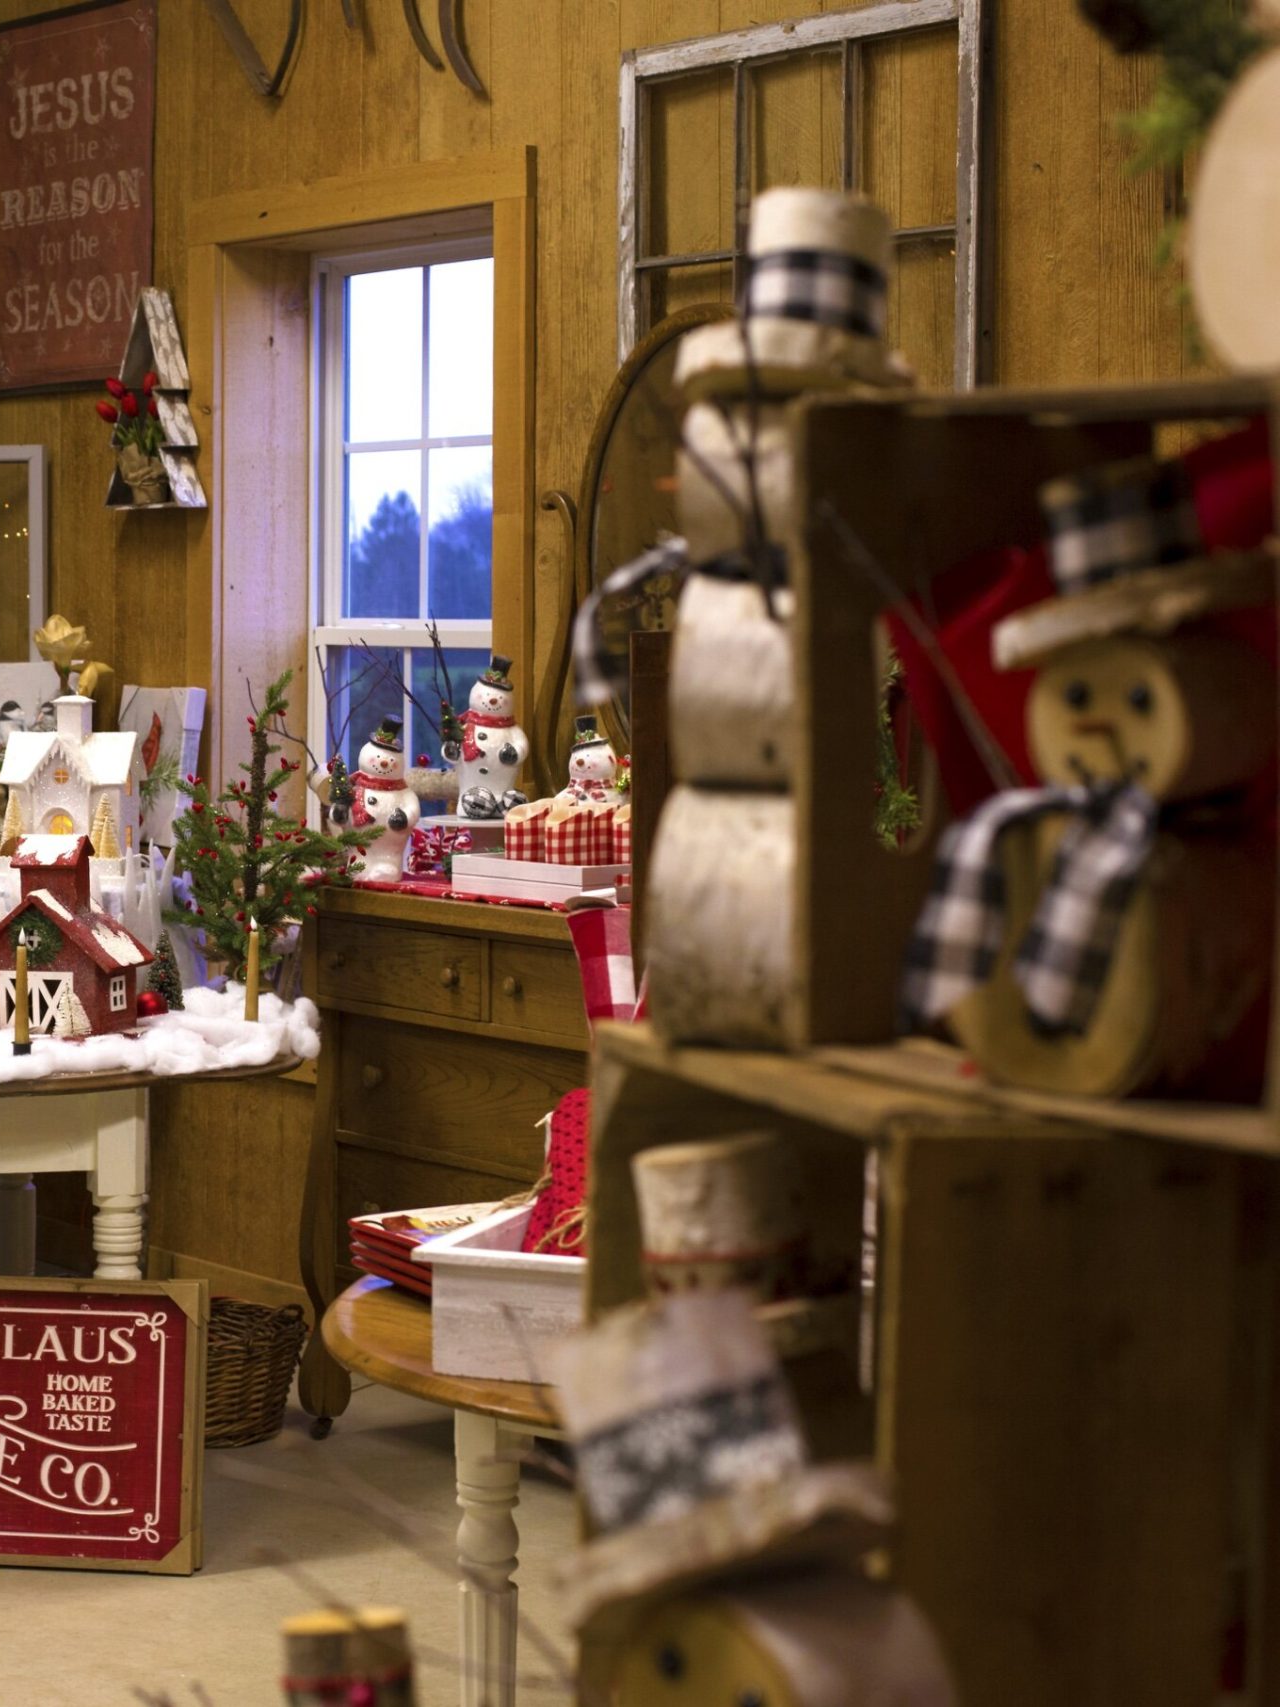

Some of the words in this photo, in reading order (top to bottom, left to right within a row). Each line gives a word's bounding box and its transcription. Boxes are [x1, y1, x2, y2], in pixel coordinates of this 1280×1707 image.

[9, 66, 134, 140] JESUS
[43, 141, 57, 168] is
[65, 133, 100, 164] the
[0, 168, 144, 230] REASON
[39, 234, 65, 266] for
[69, 229, 100, 261] the
[4, 271, 140, 334] SEASON
[46, 1373, 113, 1393] HOME
[42, 1393, 116, 1413] BAKED
[45, 1413, 112, 1433] TASTE
[40, 1454, 119, 1507] CO.
